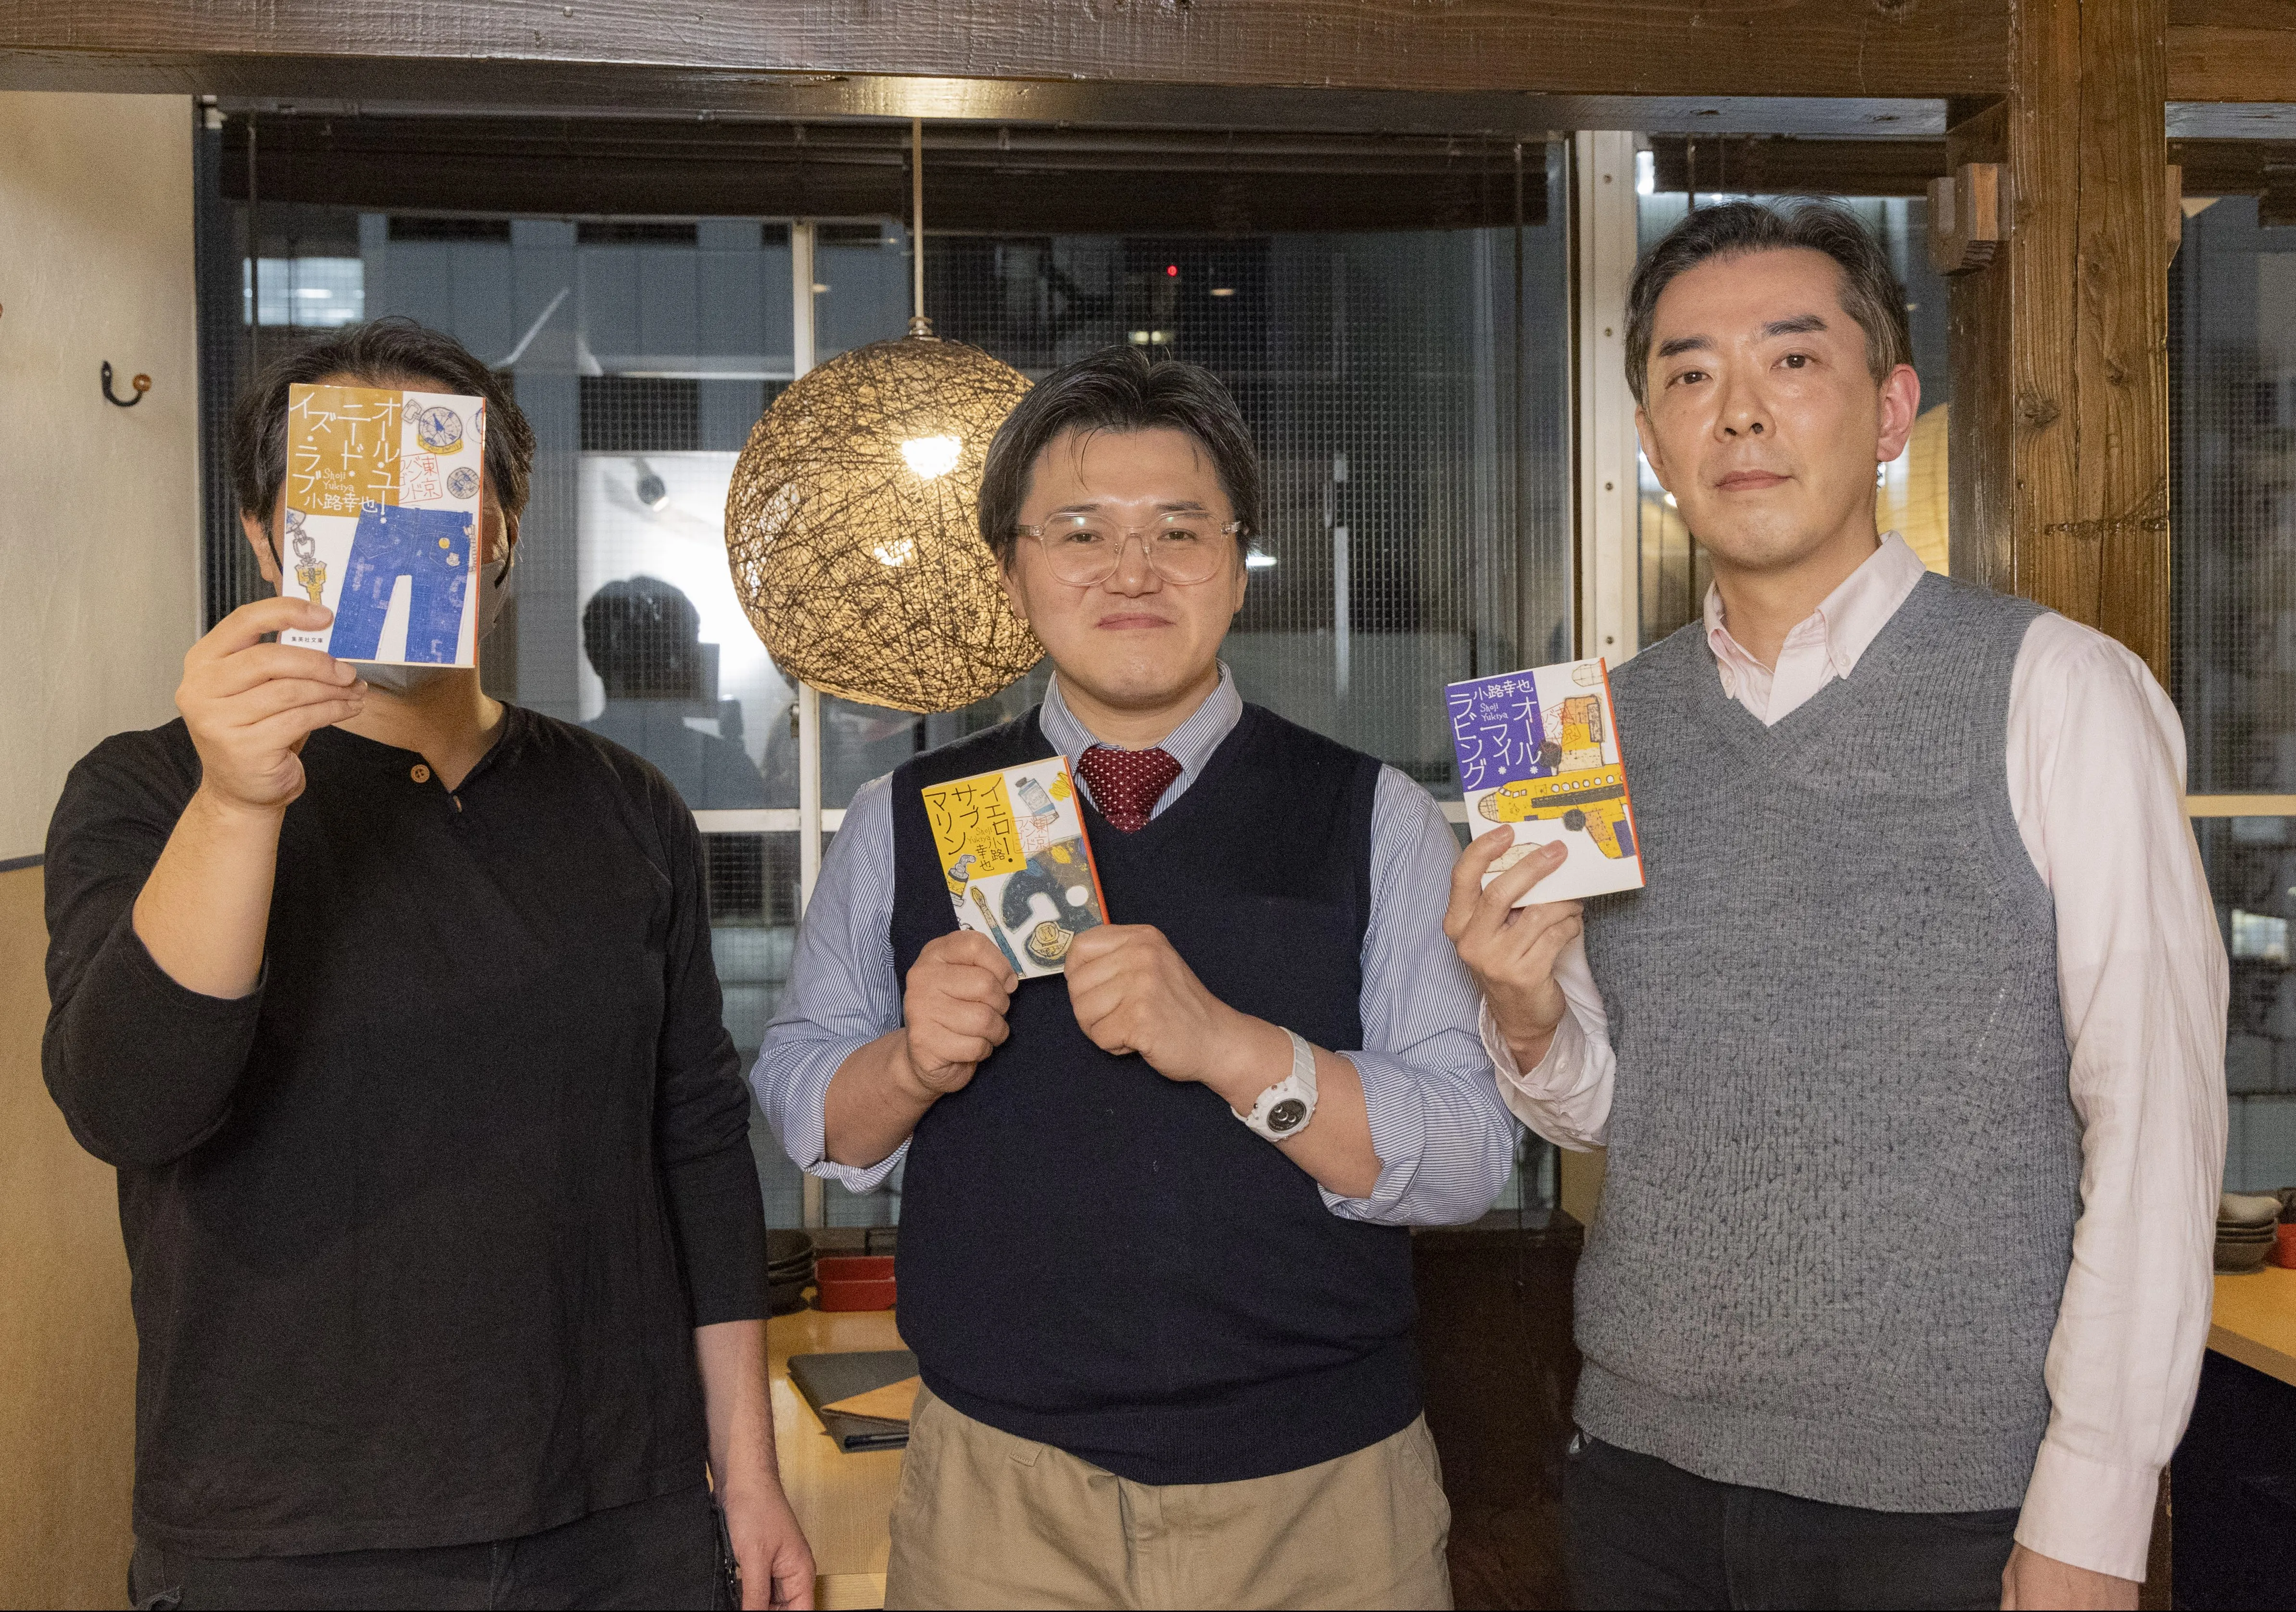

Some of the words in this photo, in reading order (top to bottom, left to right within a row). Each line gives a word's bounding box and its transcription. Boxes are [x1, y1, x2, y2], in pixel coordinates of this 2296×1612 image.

[323, 468, 346, 481] Shoji
[406, 455, 423, 500] バンド
[421, 456, 437, 498] 東京
[323, 480, 355, 492] Yukiya
[304, 492, 378, 513] 小路幸也
[1473, 680, 1534, 701] 小路幸也
[1480, 703, 1499, 713] Shoji
[1480, 712, 1509, 721] Yukiya
[1449, 693, 1486, 790] ラビング
[951, 784, 979, 828] サブ
[925, 792, 966, 856] マリン
[976, 827, 993, 836] Shoji
[967, 835, 992, 844] Yukiya
